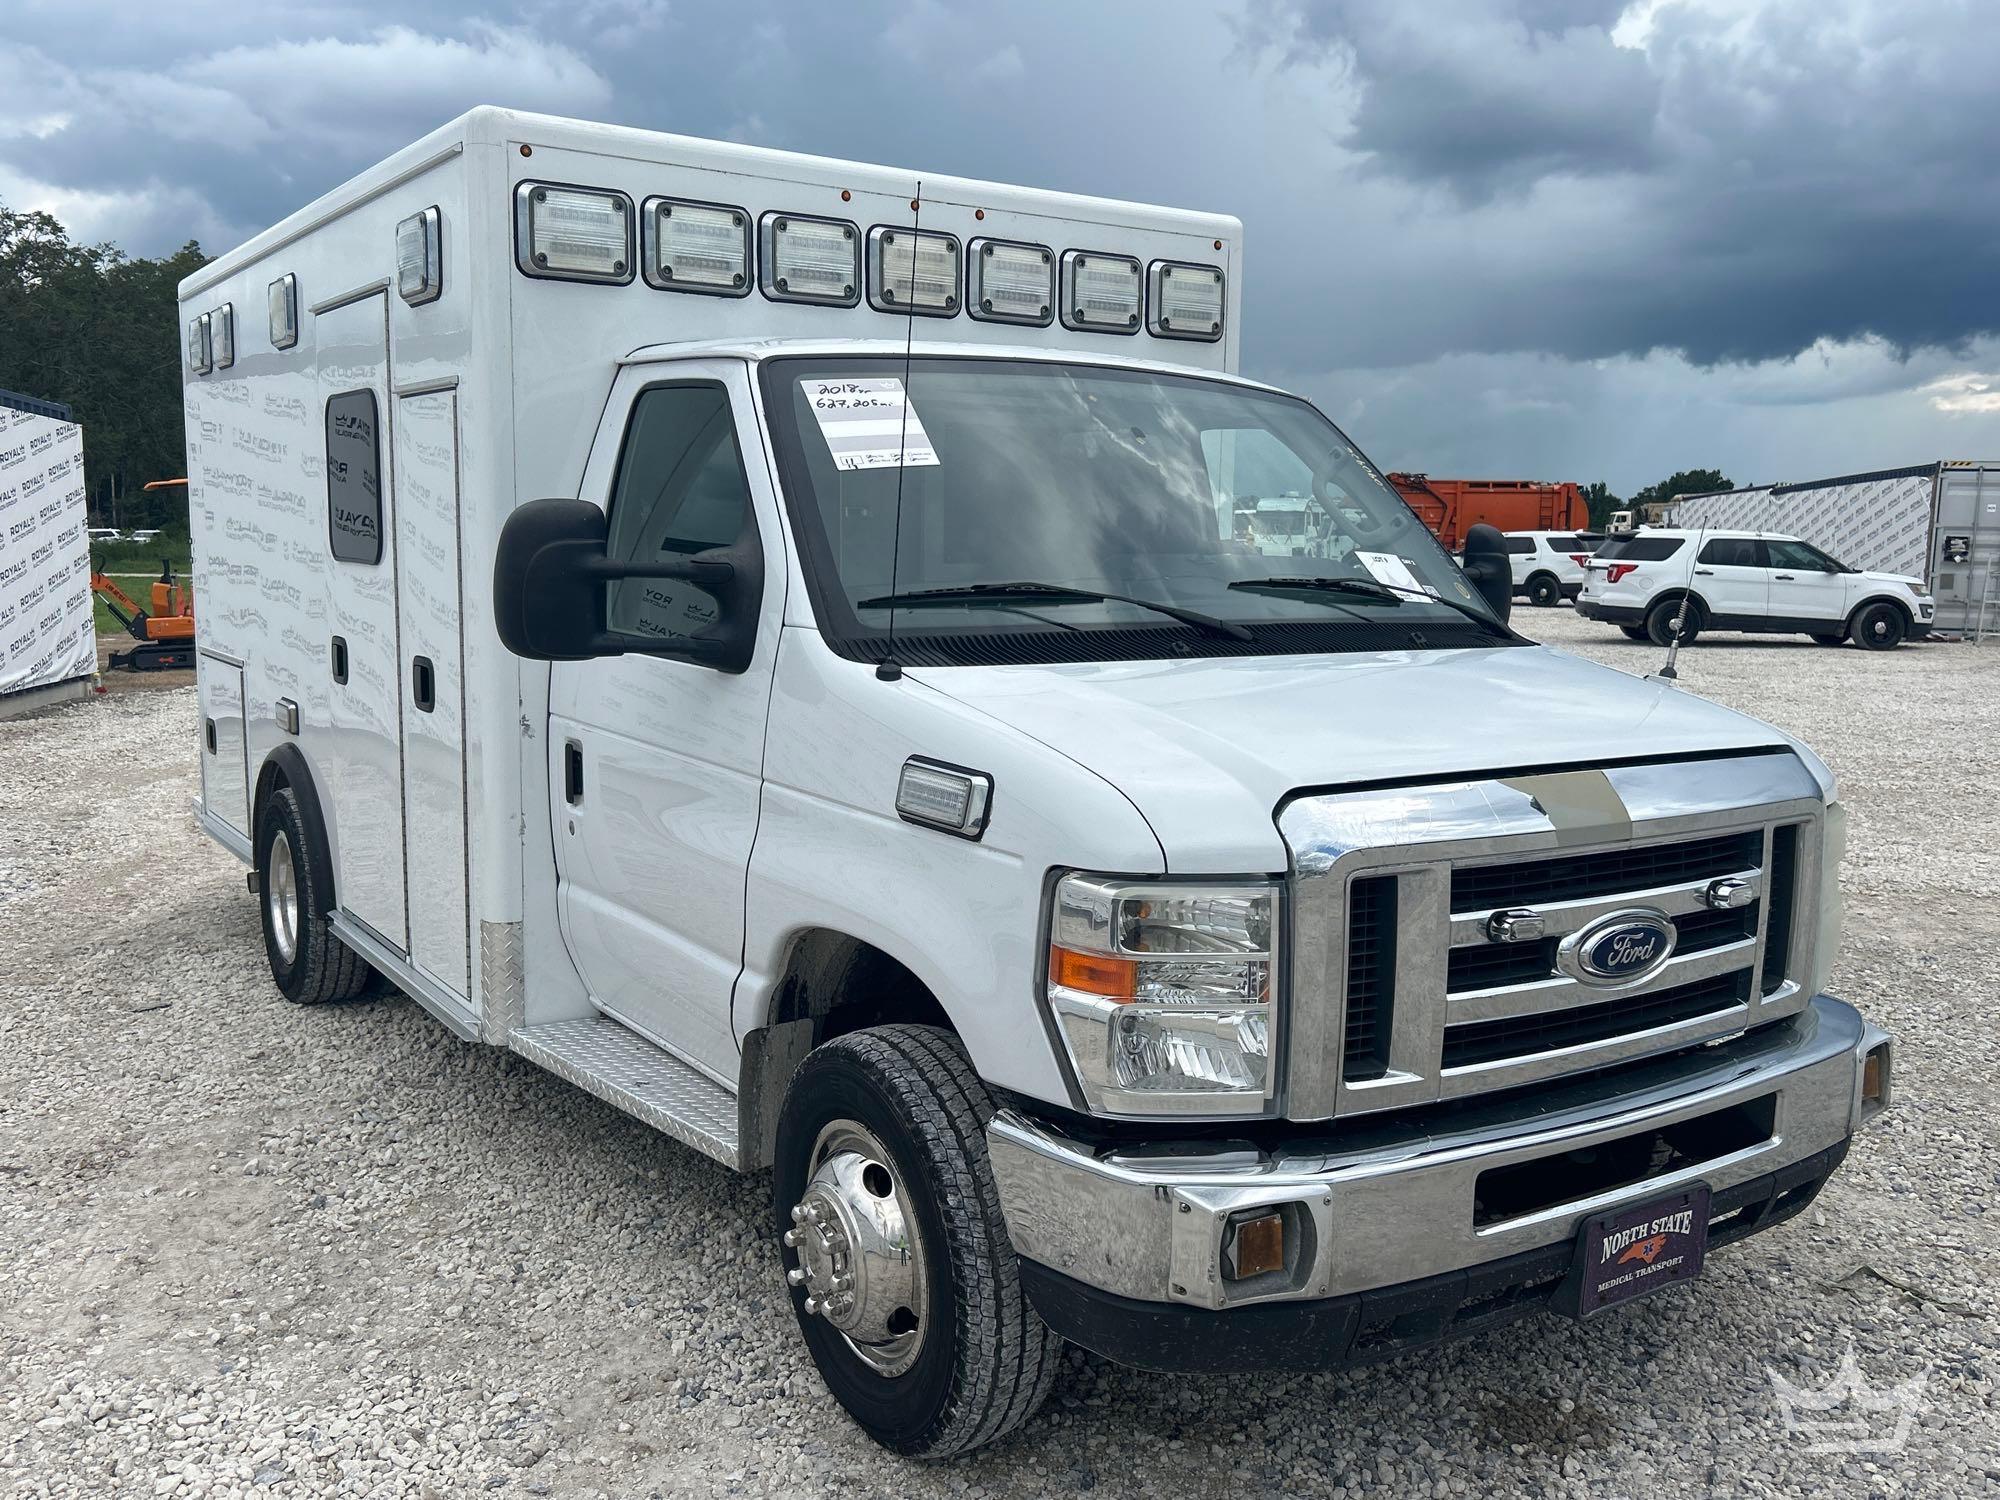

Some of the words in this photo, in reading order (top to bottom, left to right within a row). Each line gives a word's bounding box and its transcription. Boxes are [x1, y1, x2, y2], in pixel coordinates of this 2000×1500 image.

[30, 437, 47, 450] ROYAL
[0, 447, 21, 463] ROYAL
[48, 463, 66, 477] ROYAL
[22, 476, 41, 490] ROYAL
[40, 502, 57, 518] ROYAL
[10, 518, 31, 536] ROYAL
[57, 528, 75, 544] ROYAL
[31, 545, 49, 562] ROYAL
[0, 562, 21, 582] ROYAL
[48, 570, 66, 587] ROYAL
[20, 589, 41, 607] ROYAL
[66, 592, 82, 609] ROYAL
[40, 613, 58, 630] ROYAL
[10, 633, 31, 653] ROYAL
[57, 635, 74, 653] ROYAL
[1607, 932, 1655, 966] Ford
[1600, 1222, 1649, 1264] NORTH
[1651, 1210, 1693, 1235] STATE
[1597, 1272, 1634, 1293] MEDICAL
[1635, 1256, 1684, 1279] TRANSPORT
